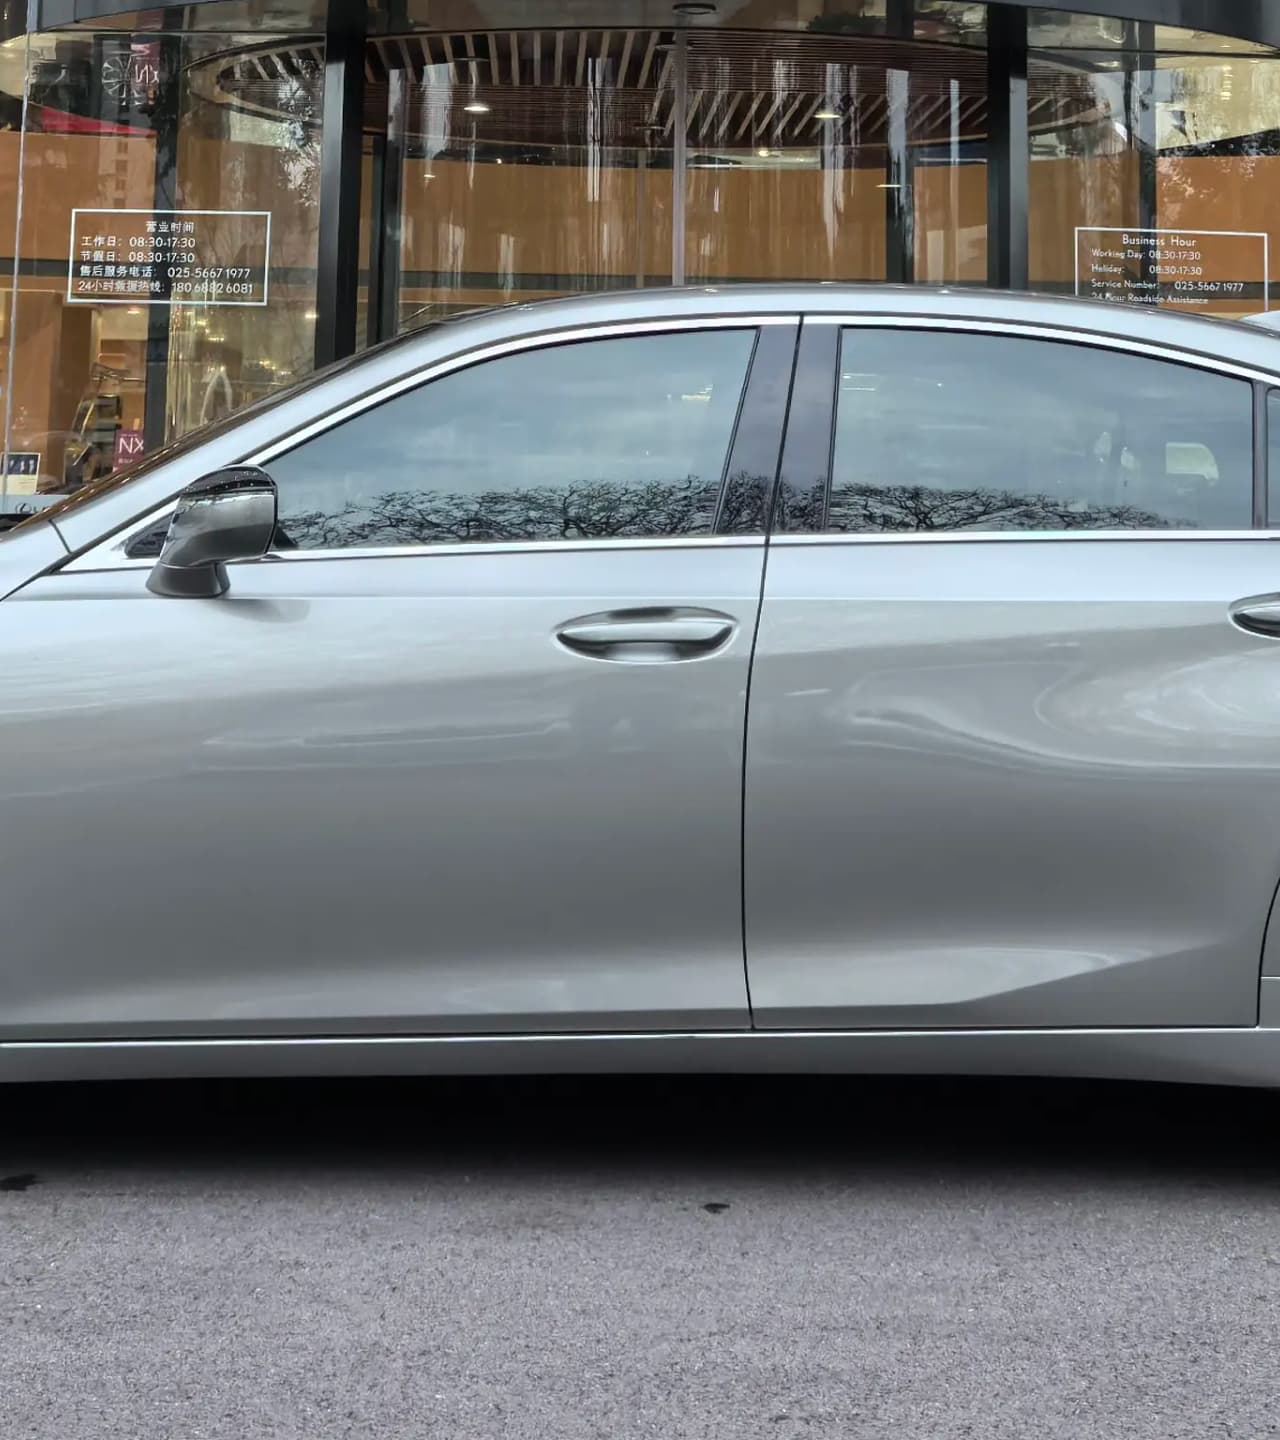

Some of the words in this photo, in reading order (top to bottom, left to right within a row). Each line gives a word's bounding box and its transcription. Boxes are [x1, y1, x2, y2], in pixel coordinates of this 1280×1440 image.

[146, 221, 194, 233] 营业时间
[129, 236, 195, 248] 08:30-17:30
[1122, 234, 1165, 246] Business
[1170, 235, 1197, 247] Hour
[128, 251, 195, 263] 08:30-17:30
[1091, 248, 1126, 259] Working
[1091, 278, 1122, 288] Service
[118, 437, 144, 454] NX
